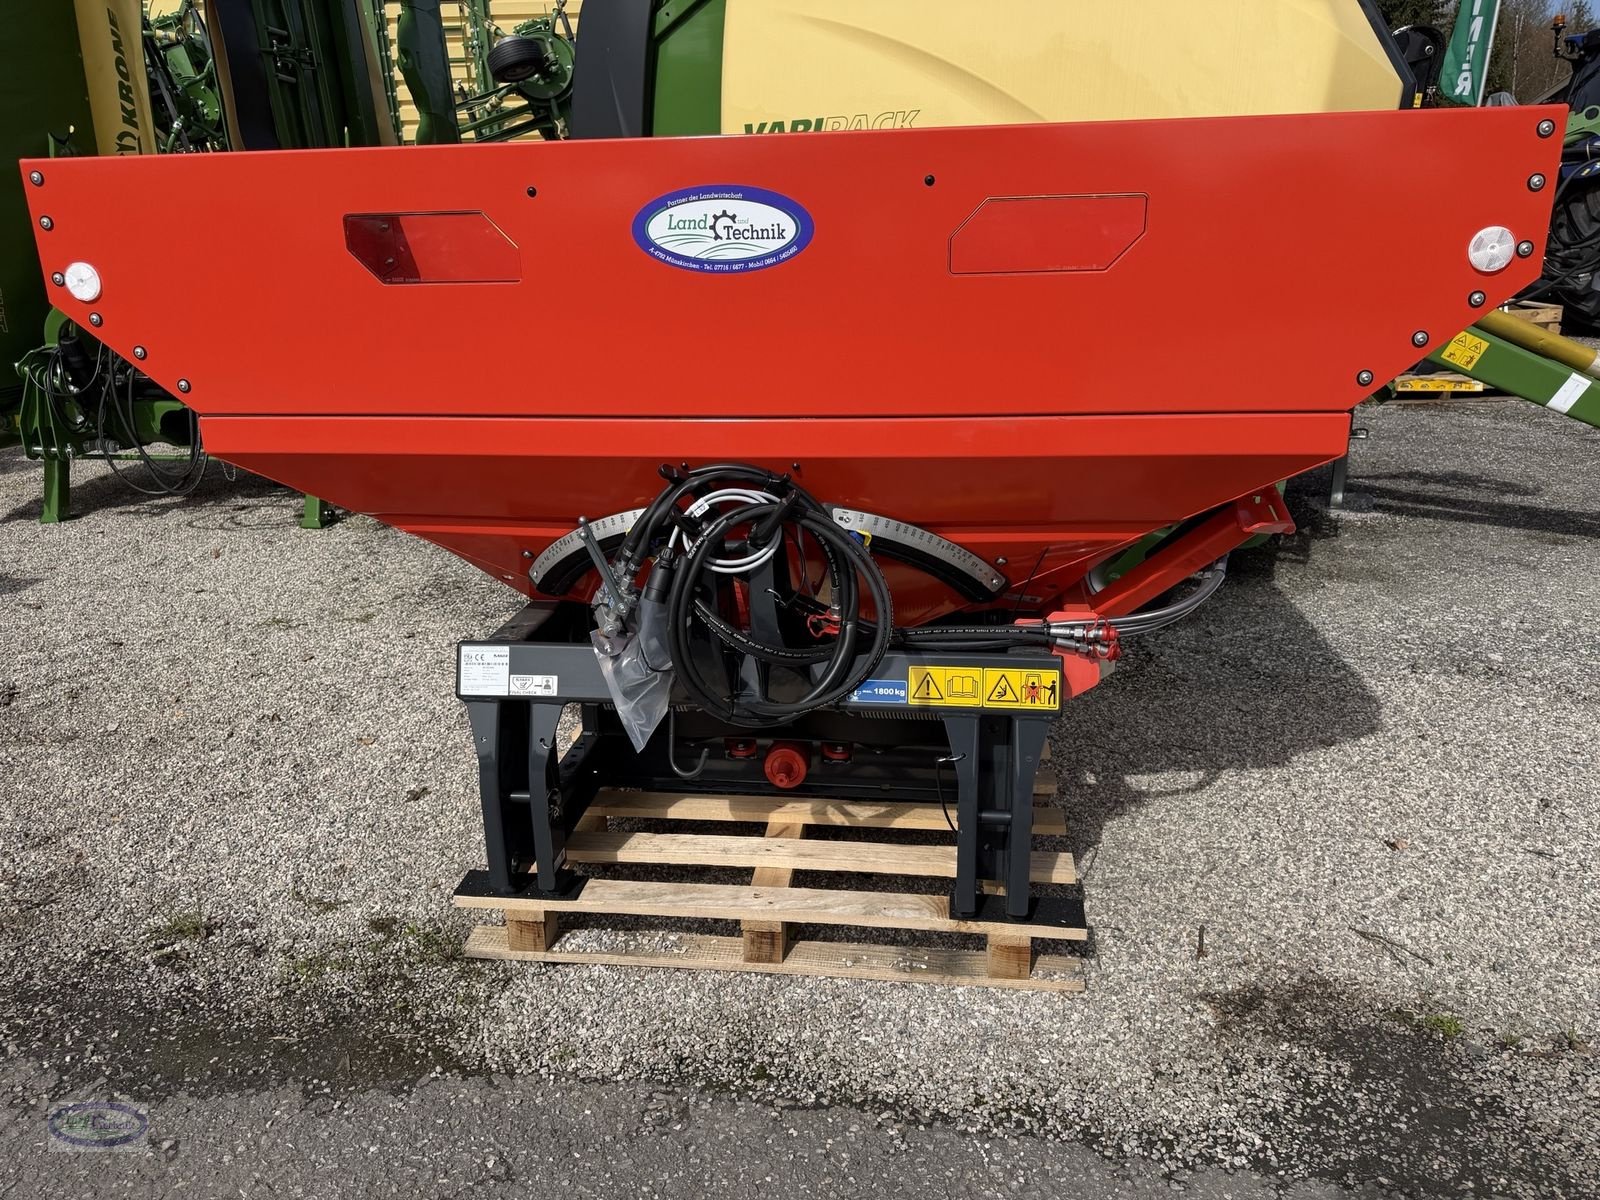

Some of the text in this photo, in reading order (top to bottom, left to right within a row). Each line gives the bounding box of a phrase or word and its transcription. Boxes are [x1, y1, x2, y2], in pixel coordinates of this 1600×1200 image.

[107, 8, 140, 130] KRONE
[667, 198, 688, 208] Partner
[667, 214, 708, 230] Land
[723, 223, 786, 240] Technik
